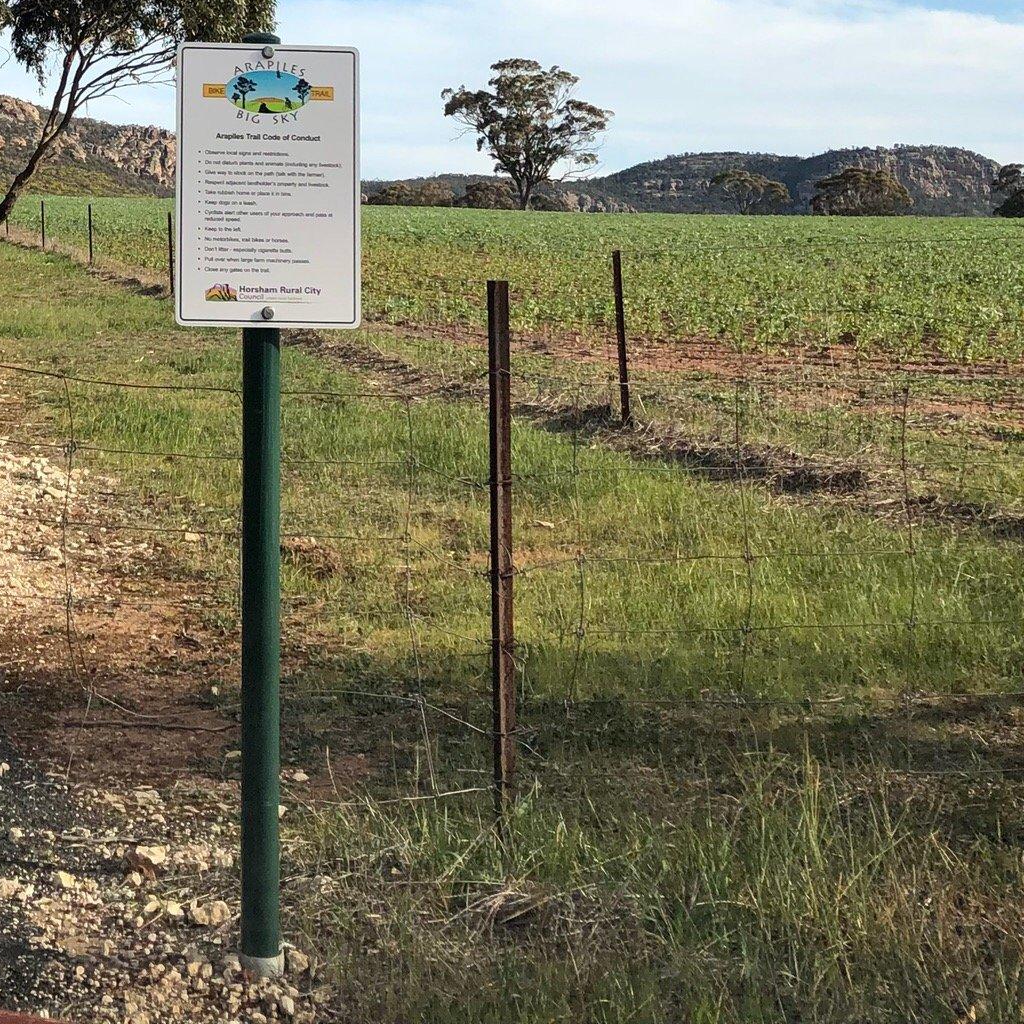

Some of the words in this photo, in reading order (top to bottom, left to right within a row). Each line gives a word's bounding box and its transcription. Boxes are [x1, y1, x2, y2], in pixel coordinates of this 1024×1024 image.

[234, 61, 306, 76] ARAPILES
[236, 110, 260, 124] BIG
[273, 111, 298, 124] SKY
[305, 287, 321, 295] City
